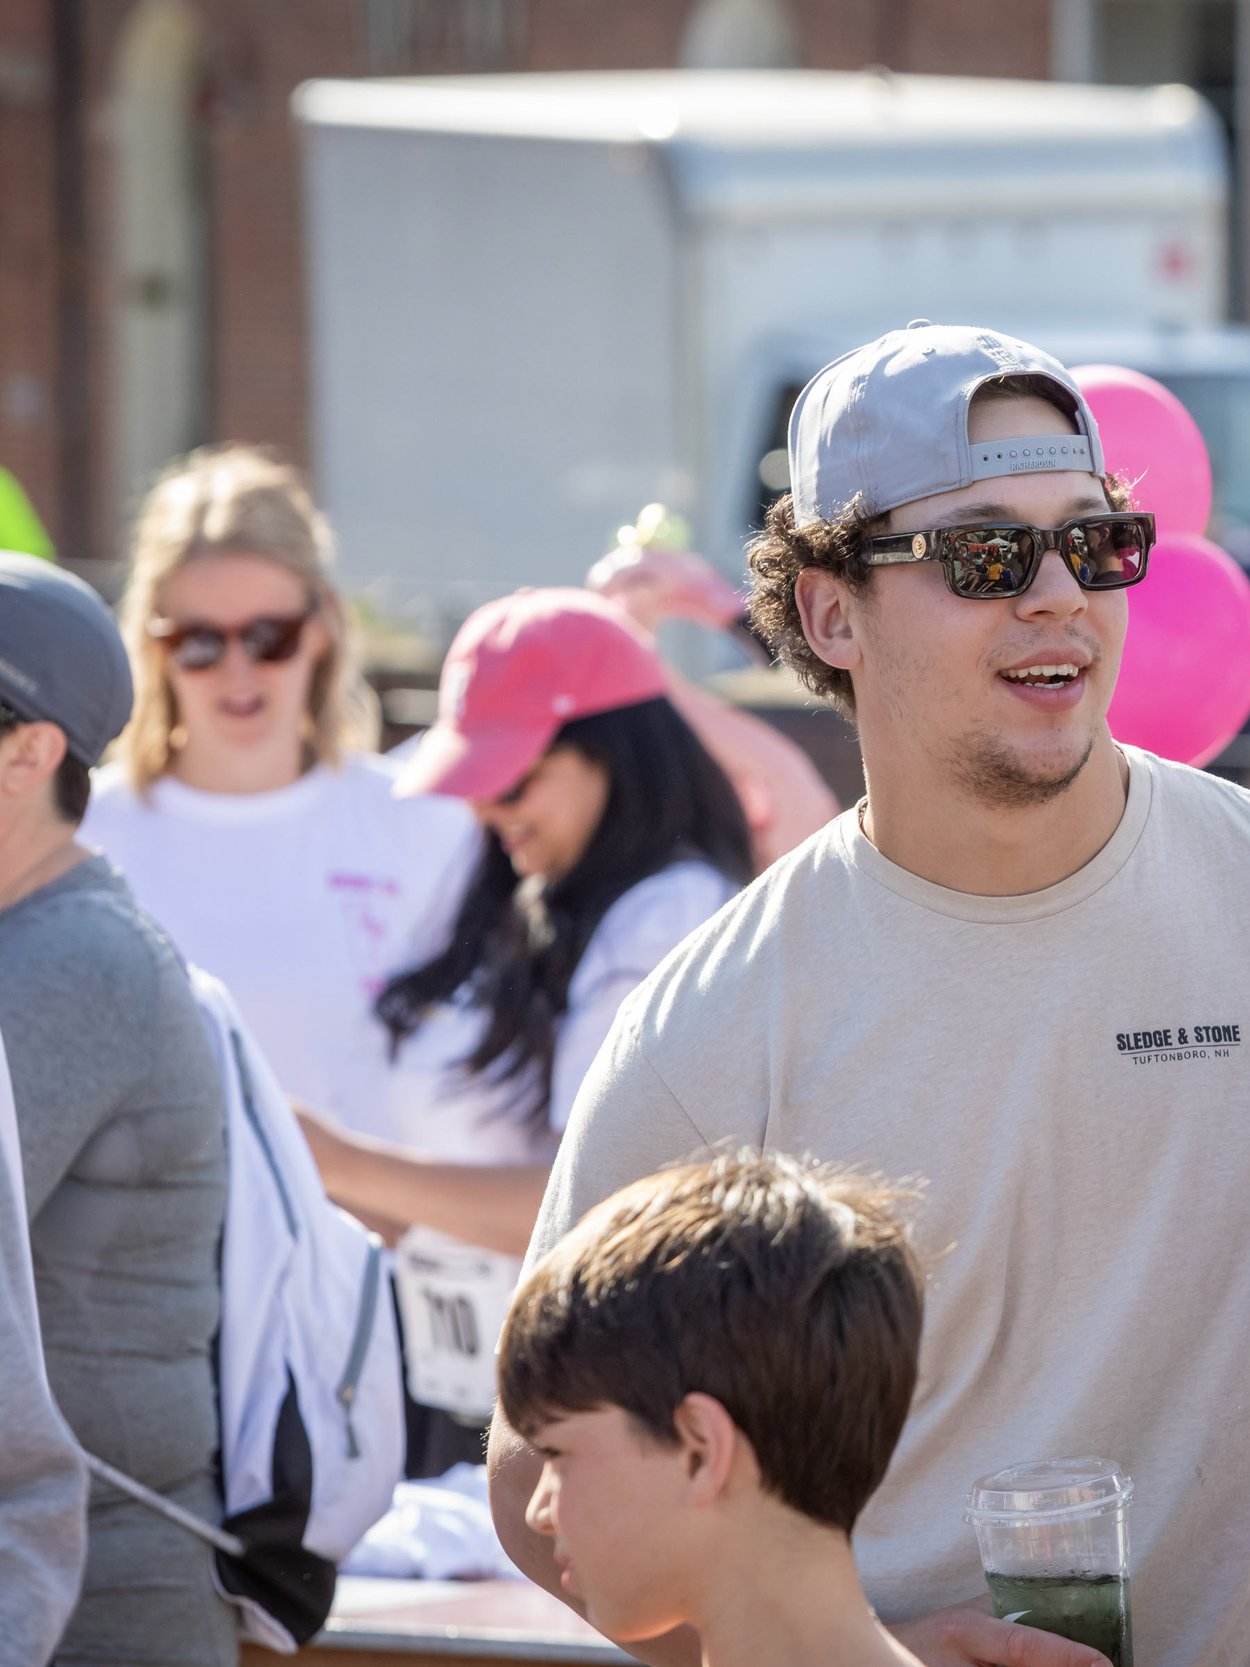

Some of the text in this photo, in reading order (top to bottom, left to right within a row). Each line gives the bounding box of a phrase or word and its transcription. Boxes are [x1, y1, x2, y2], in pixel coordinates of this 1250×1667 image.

[1011, 459, 1057, 471] RICHARDSON
[1116, 1025, 1241, 1051] SLEDGE & STONE
[1133, 1049, 1230, 1065] TUFTONBORO, NH
